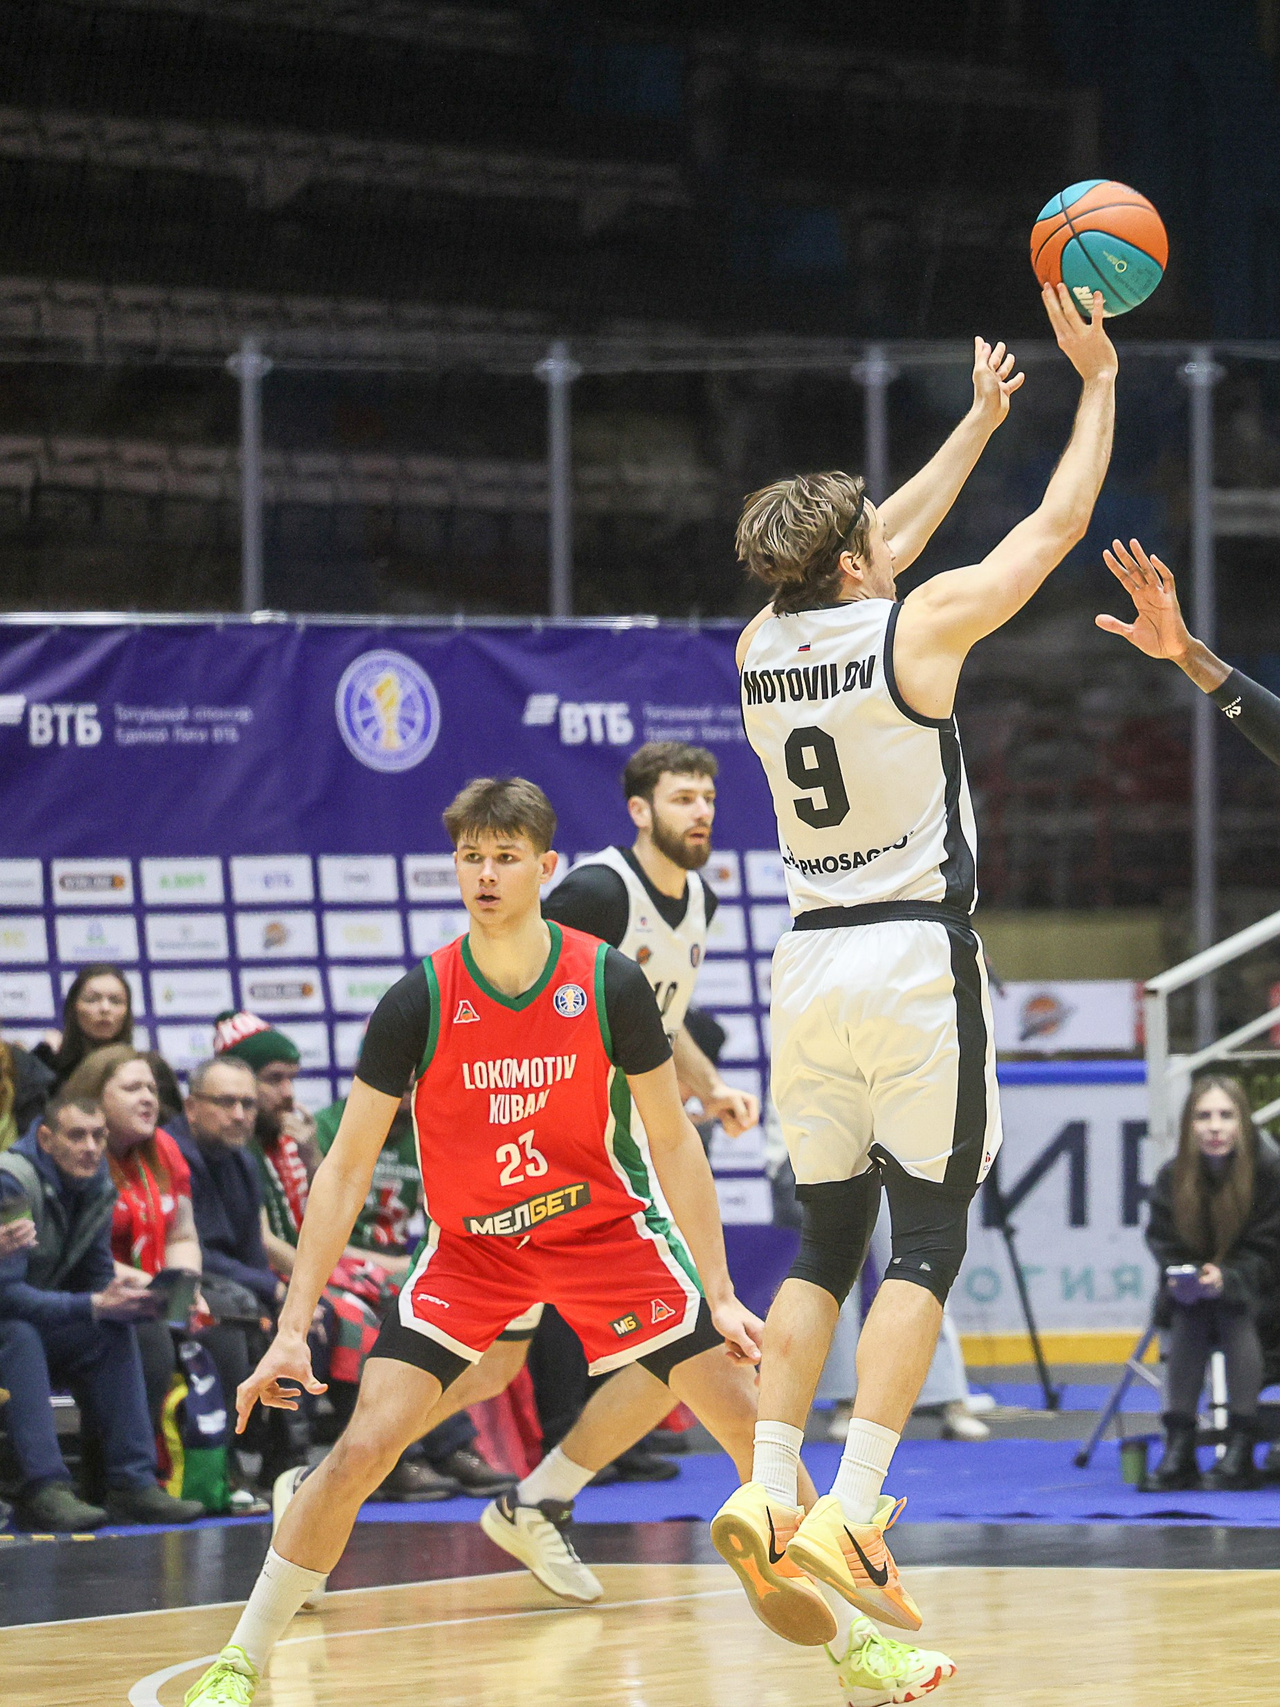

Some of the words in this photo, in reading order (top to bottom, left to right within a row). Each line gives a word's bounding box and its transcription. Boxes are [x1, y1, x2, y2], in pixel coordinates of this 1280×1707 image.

[743, 655, 876, 705] MOTOVILOV
[29, 703, 102, 746] ВТБ
[560, 702, 634, 745] ВТБ
[785, 725, 850, 829] 9
[462, 1054, 577, 1090] LOKOMOTIV
[489, 1088, 550, 1125] KUBAN
[495, 1129, 549, 1187] 23
[469, 1184, 584, 1235] МЕЛБЕТ
